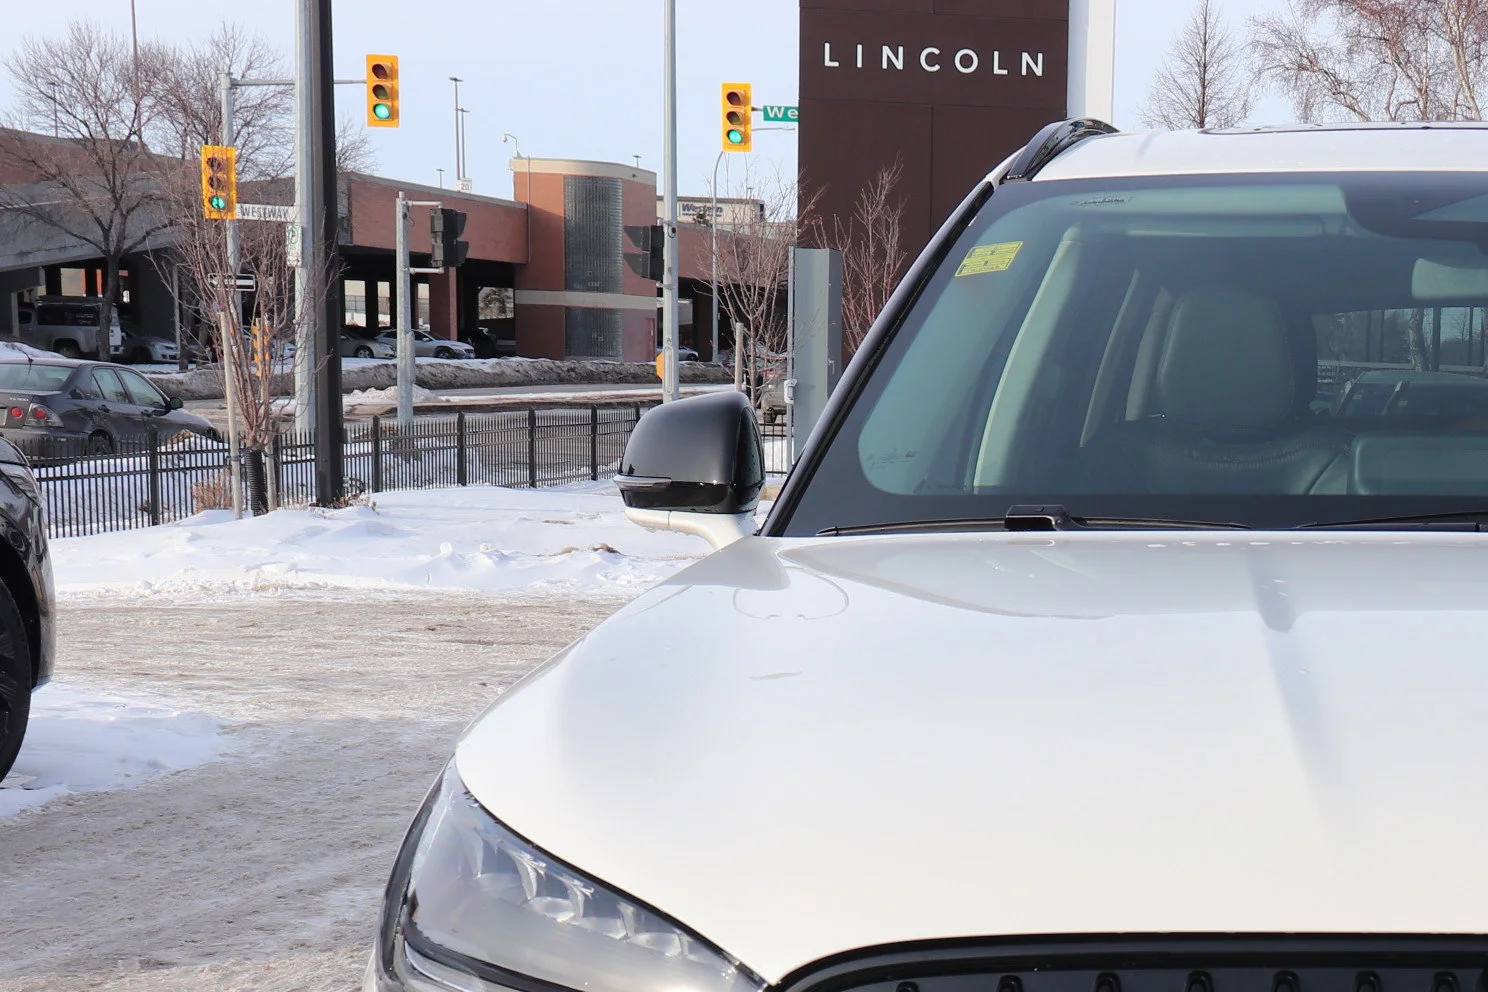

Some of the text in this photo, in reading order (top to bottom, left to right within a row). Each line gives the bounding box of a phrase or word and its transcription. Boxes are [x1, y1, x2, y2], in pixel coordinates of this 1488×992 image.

[824, 42, 1043, 77] LINCOLN
[241, 205, 289, 218] WESTWAY
[682, 203, 723, 214] Westen
